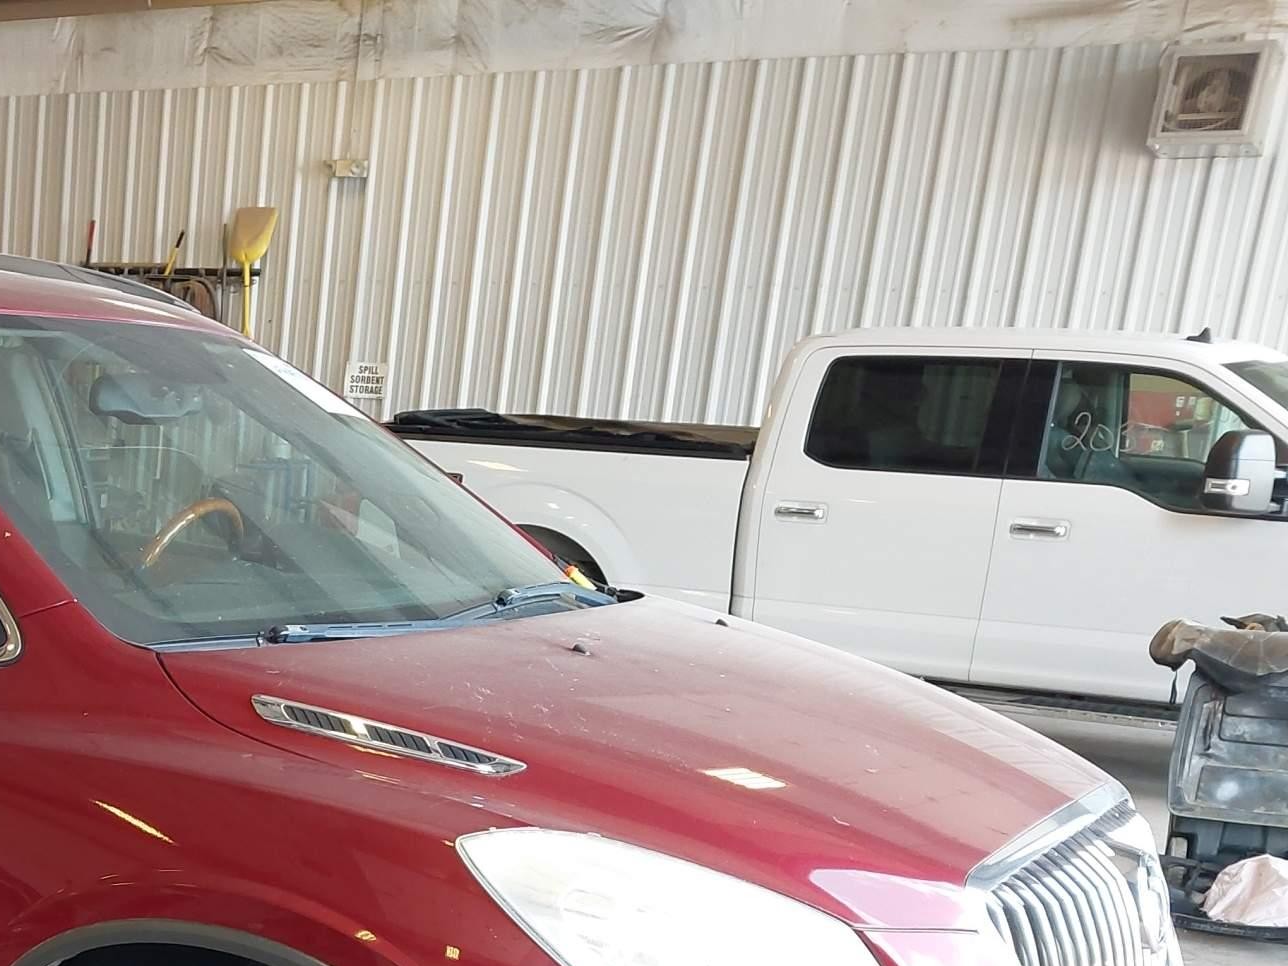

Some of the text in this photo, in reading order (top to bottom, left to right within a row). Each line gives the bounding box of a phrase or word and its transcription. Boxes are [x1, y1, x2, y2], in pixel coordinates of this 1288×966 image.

[358, 365, 379, 375] SPILL
[350, 374, 385, 385] SORBENT
[349, 384, 383, 395] STORAGE
